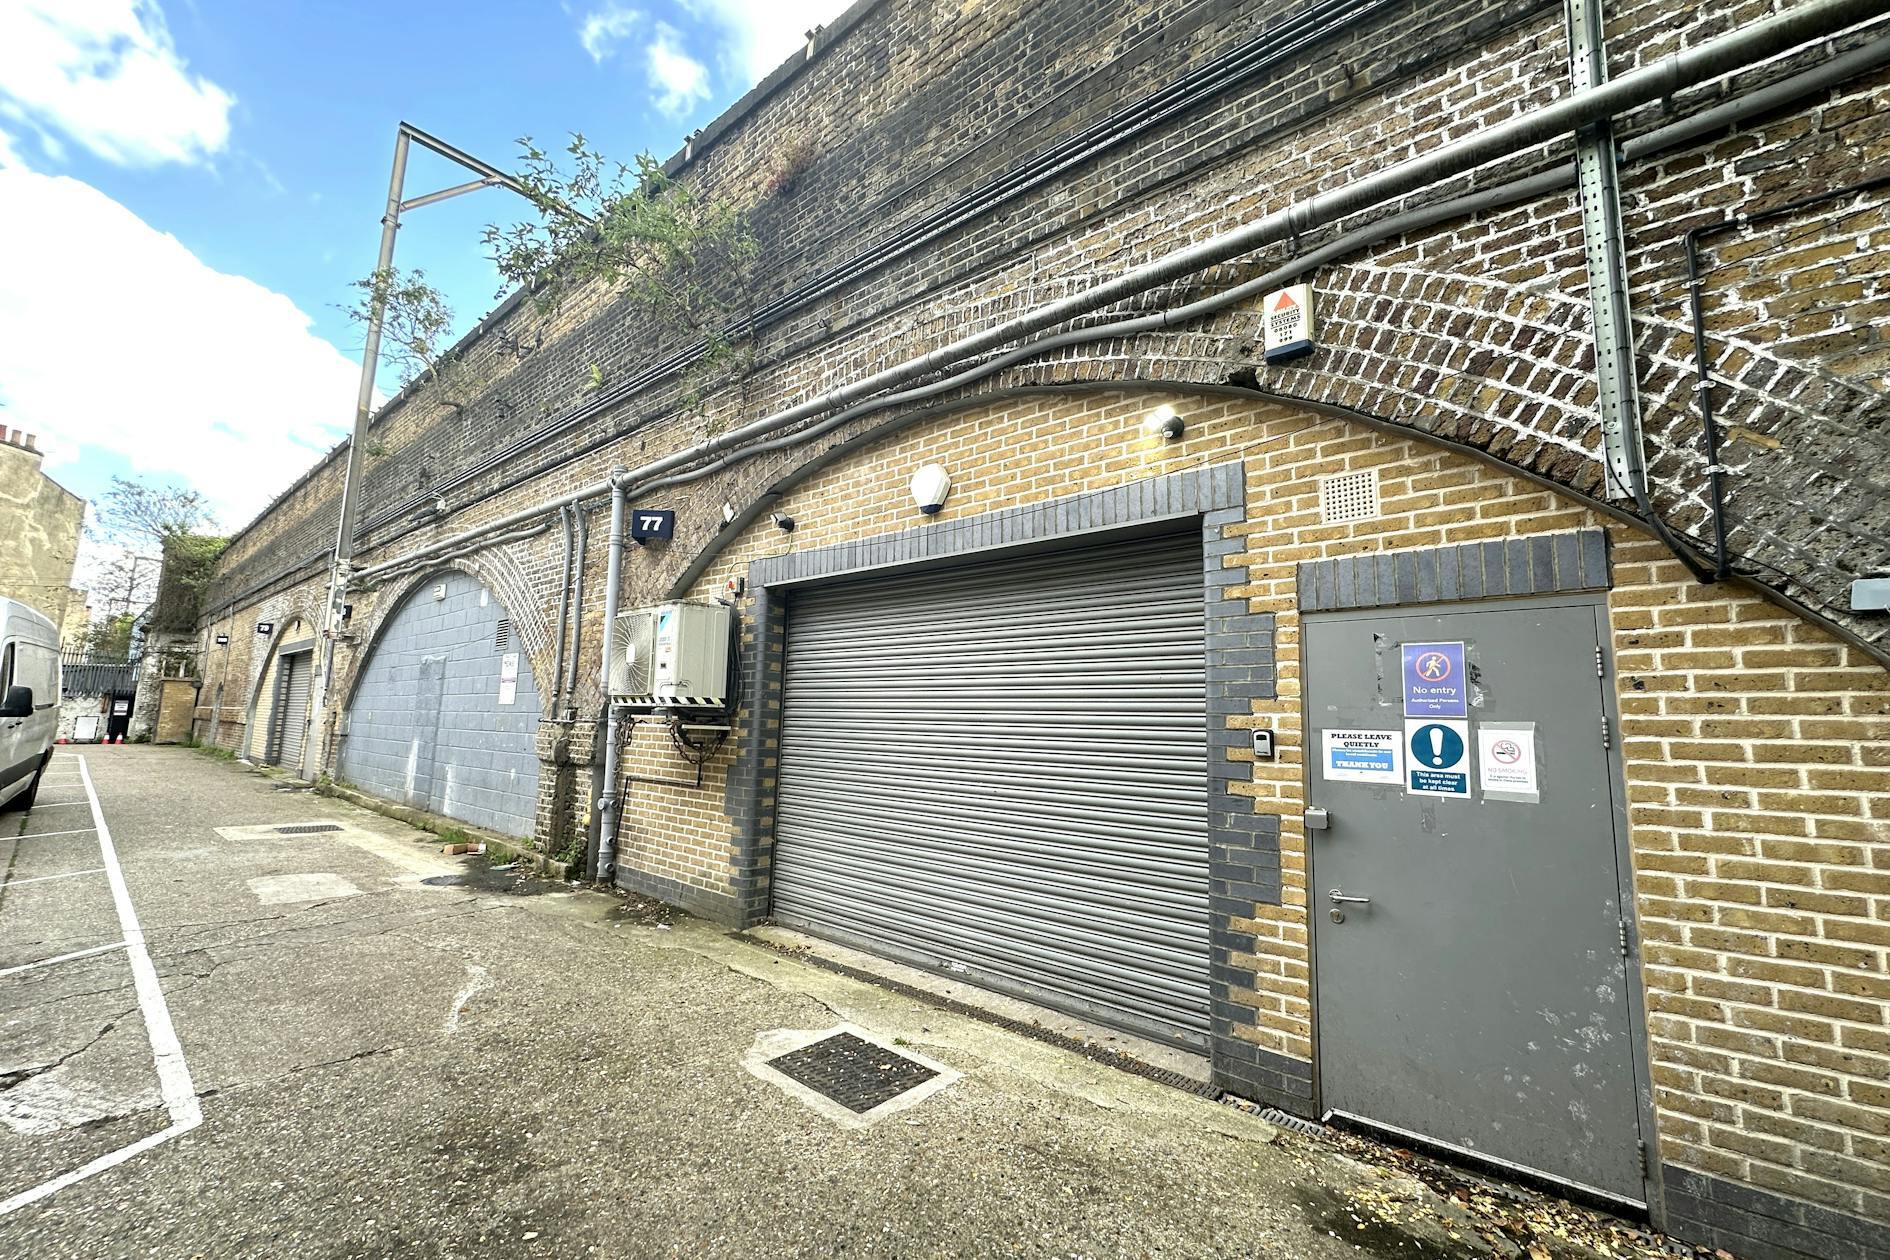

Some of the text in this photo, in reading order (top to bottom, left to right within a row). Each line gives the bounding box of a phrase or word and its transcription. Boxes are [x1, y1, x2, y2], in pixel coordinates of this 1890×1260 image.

[1270, 308, 1300, 320] SECURITY
[1271, 315, 1300, 327] SYSTEMS
[640, 516, 663, 531] 77
[1413, 686, 1456, 696] No entry
[1335, 760, 1369, 768] THANK
